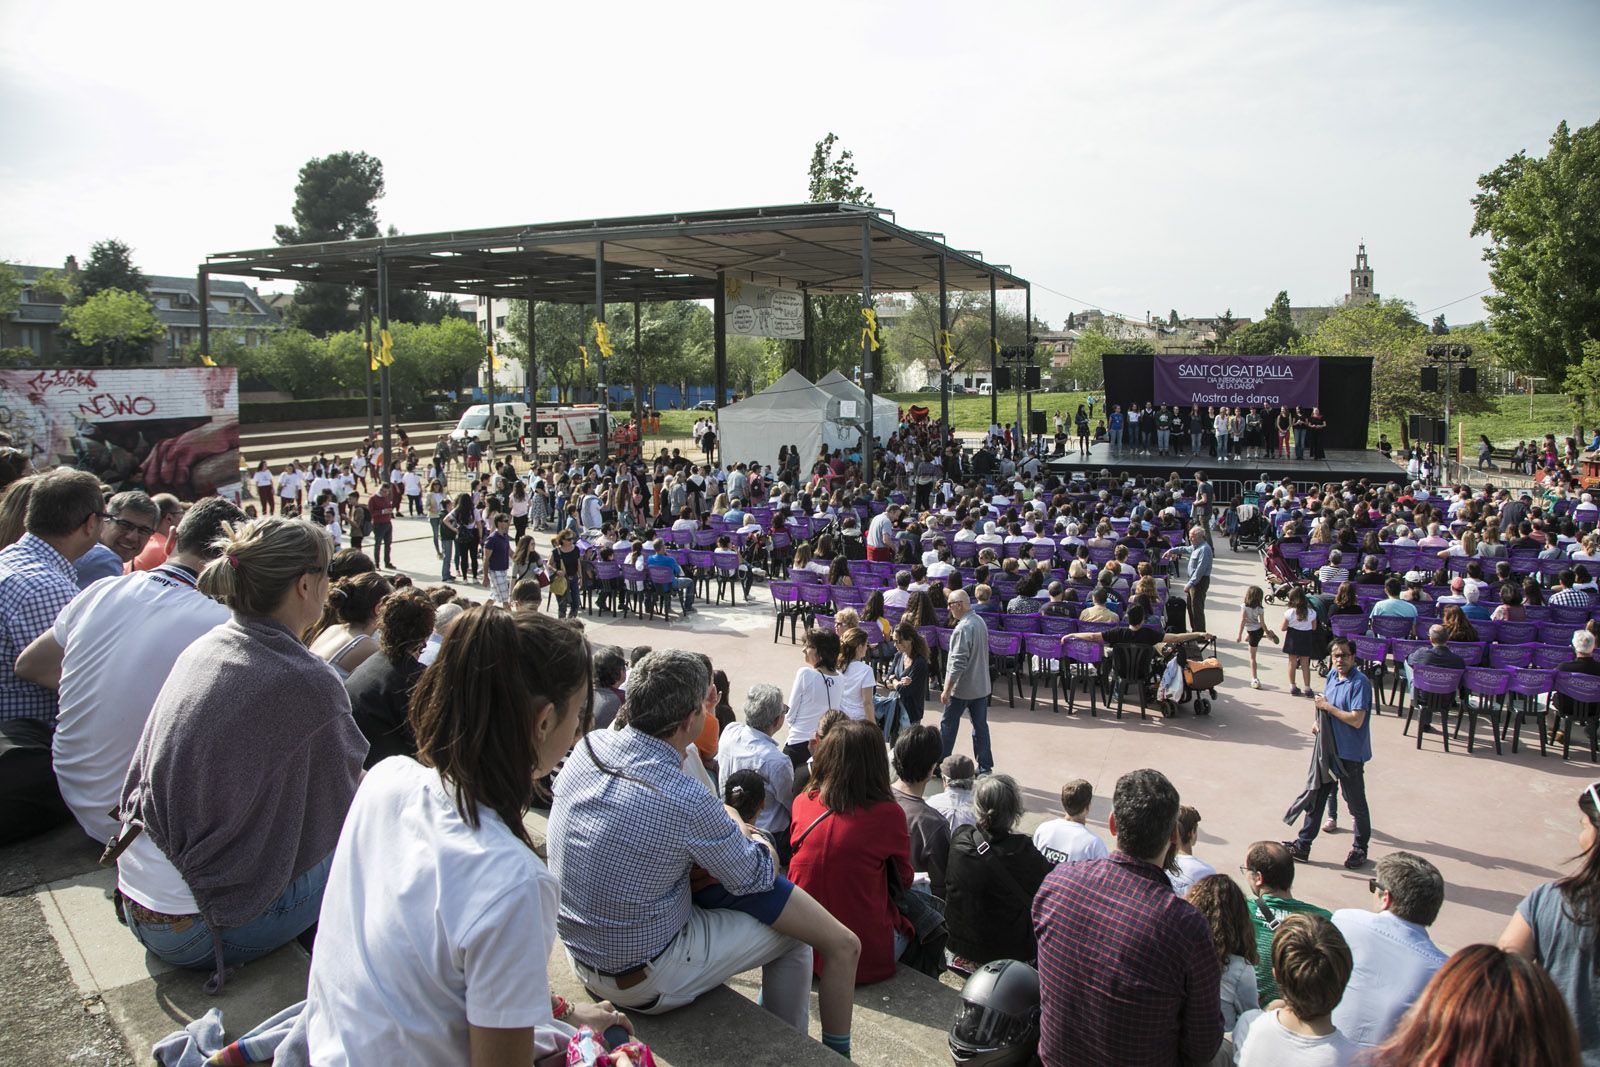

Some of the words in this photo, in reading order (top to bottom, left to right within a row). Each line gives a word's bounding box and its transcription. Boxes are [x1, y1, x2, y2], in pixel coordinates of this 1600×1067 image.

[1178, 365, 1208, 377] SANT
[1209, 365, 1256, 377] CUGAT
[1257, 365, 1293, 377] BALLA
[1191, 393, 1228, 403] Mostra
[1230, 393, 1244, 403] de
[1246, 393, 1279, 404] dansa
[1046, 850, 1066, 863] KCD
